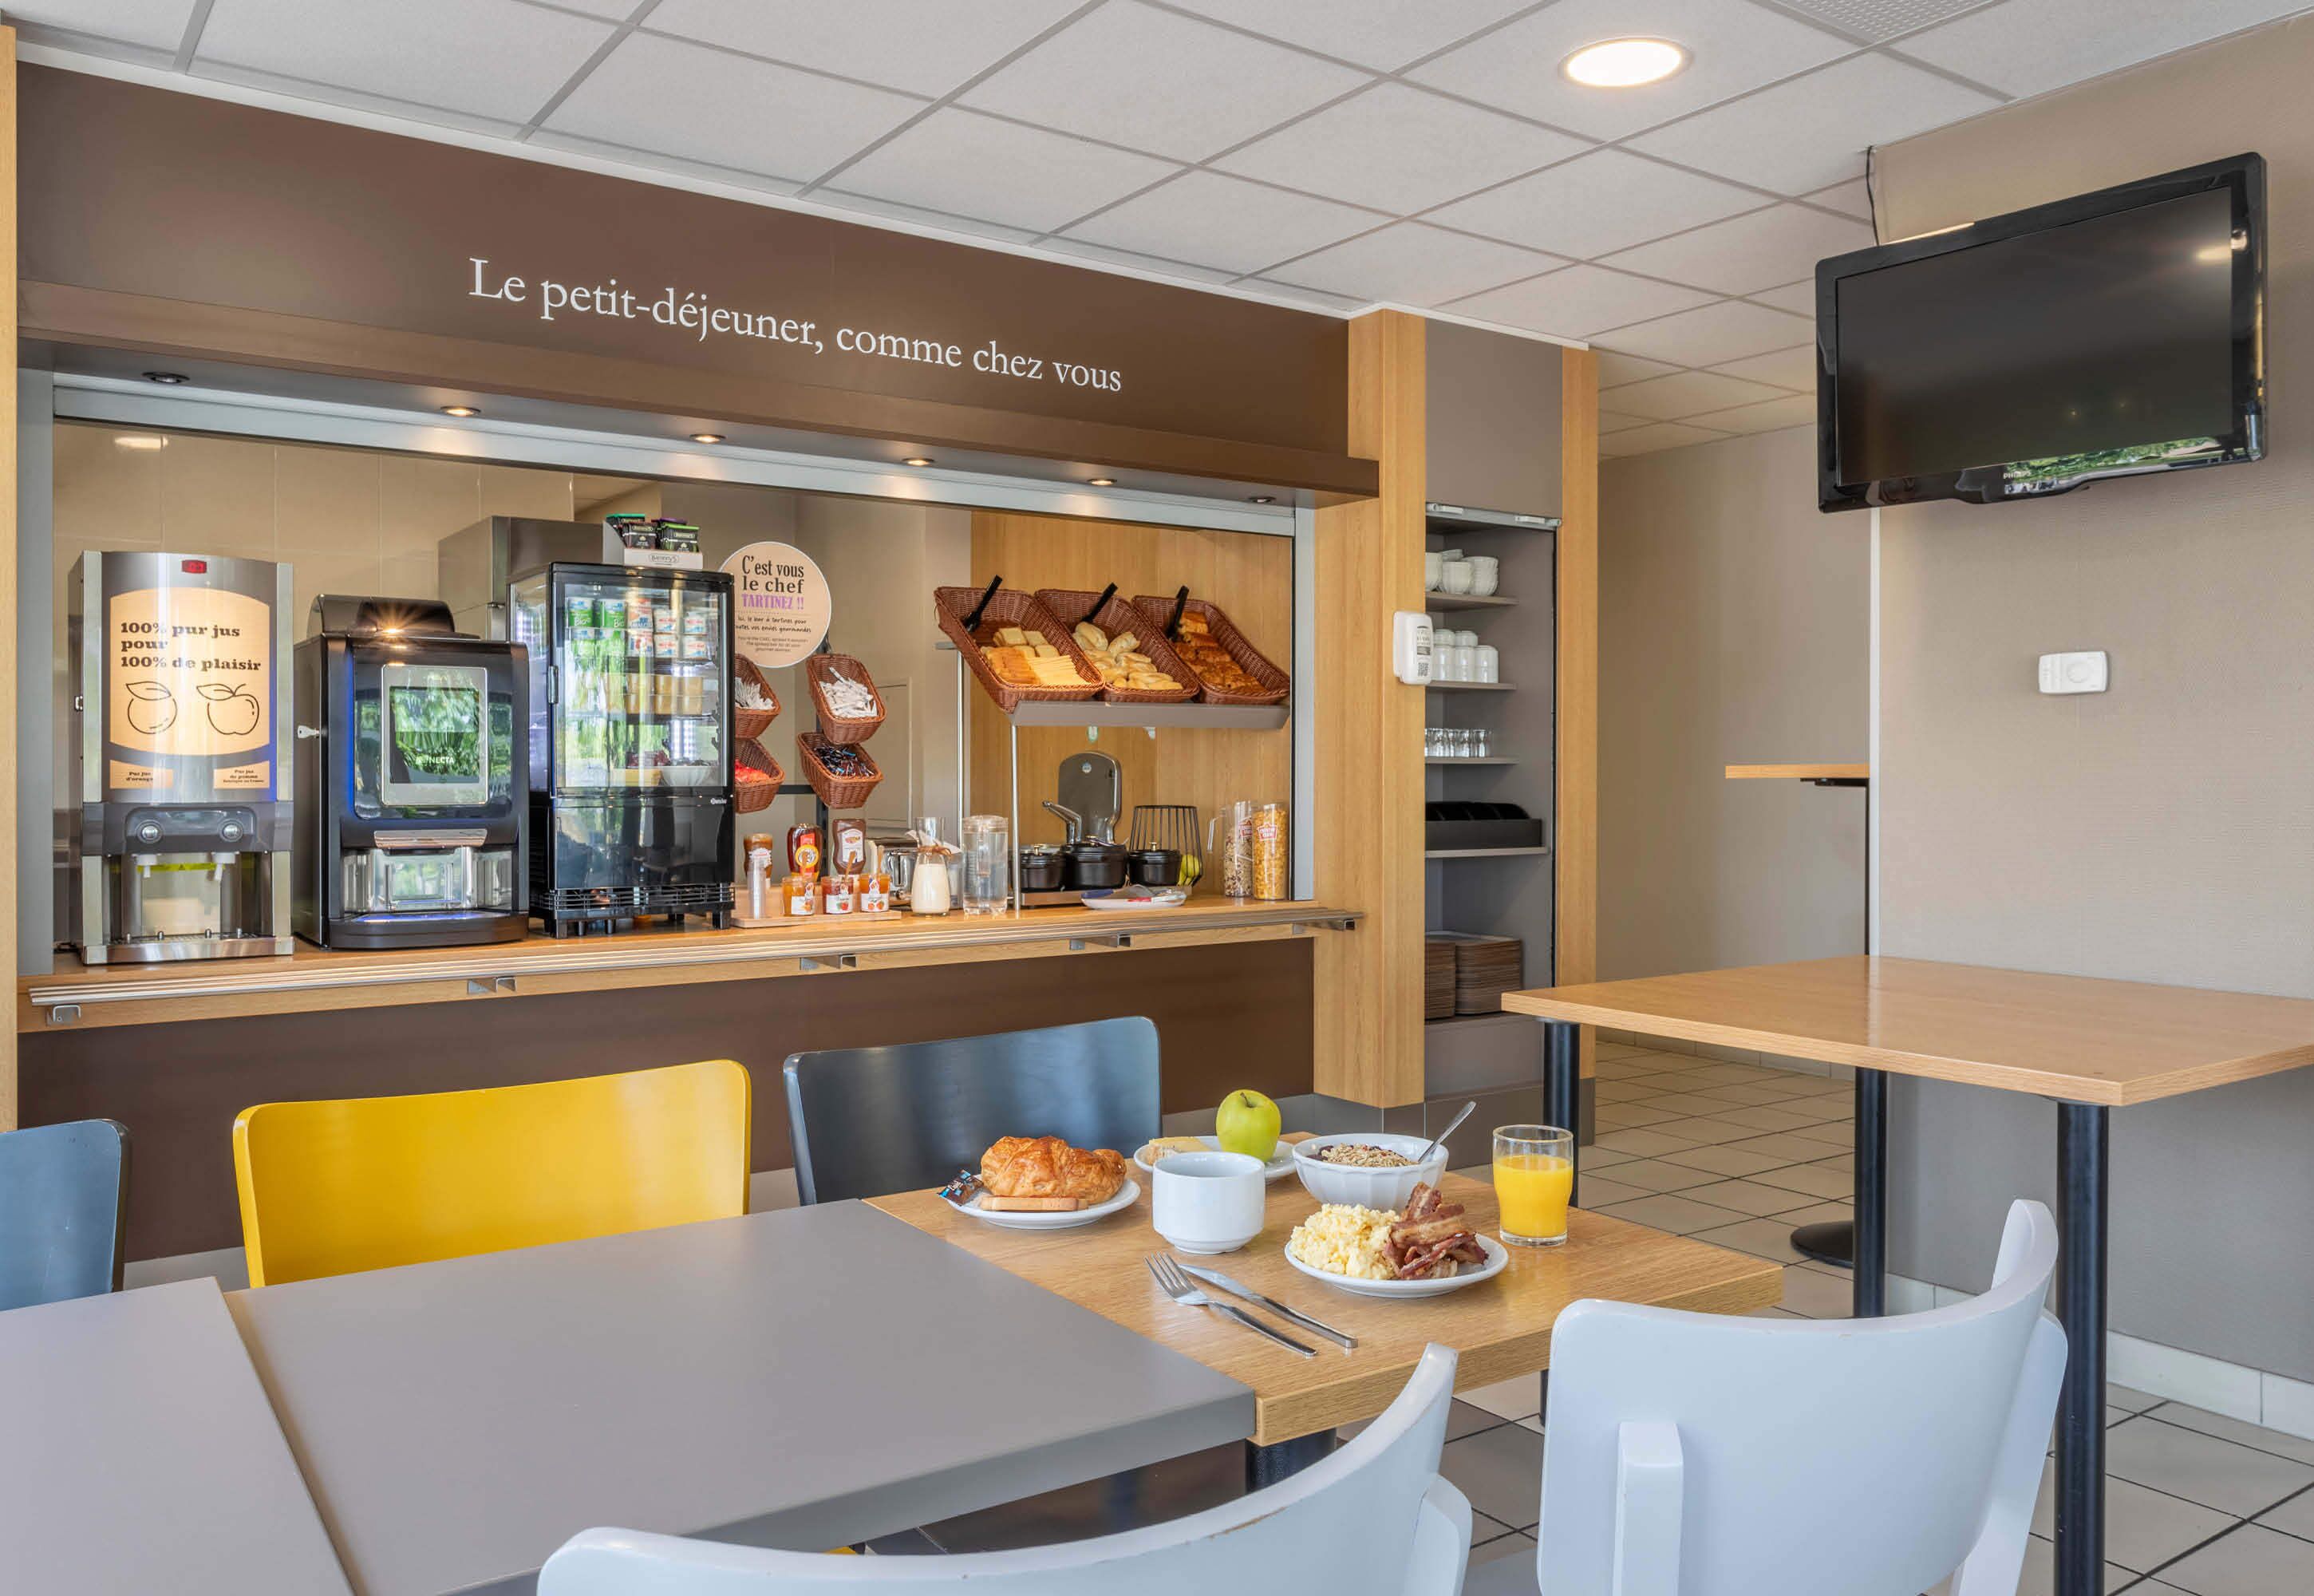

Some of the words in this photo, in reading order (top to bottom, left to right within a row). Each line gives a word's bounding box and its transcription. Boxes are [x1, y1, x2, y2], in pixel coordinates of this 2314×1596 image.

[468, 257, 527, 302] Le
[539, 279, 823, 354] petit-déjeuner,
[836, 326, 962, 367] comme
[973, 338, 1043, 380] chez
[1052, 361, 1122, 392] vous
[741, 555, 772, 576] C'est
[776, 563, 804, 578] vous
[743, 575, 759, 591] le
[765, 577, 804, 593] chef
[741, 593, 792, 610] TARTINEZ
[120, 622, 167, 634] 100%
[172, 626, 207, 637] pur
[211, 625, 240, 638] jus
[120, 640, 168, 652] pour
[120, 656, 167, 668] 100%
[172, 657, 195, 668] de
[200, 658, 261, 672] plaisir
